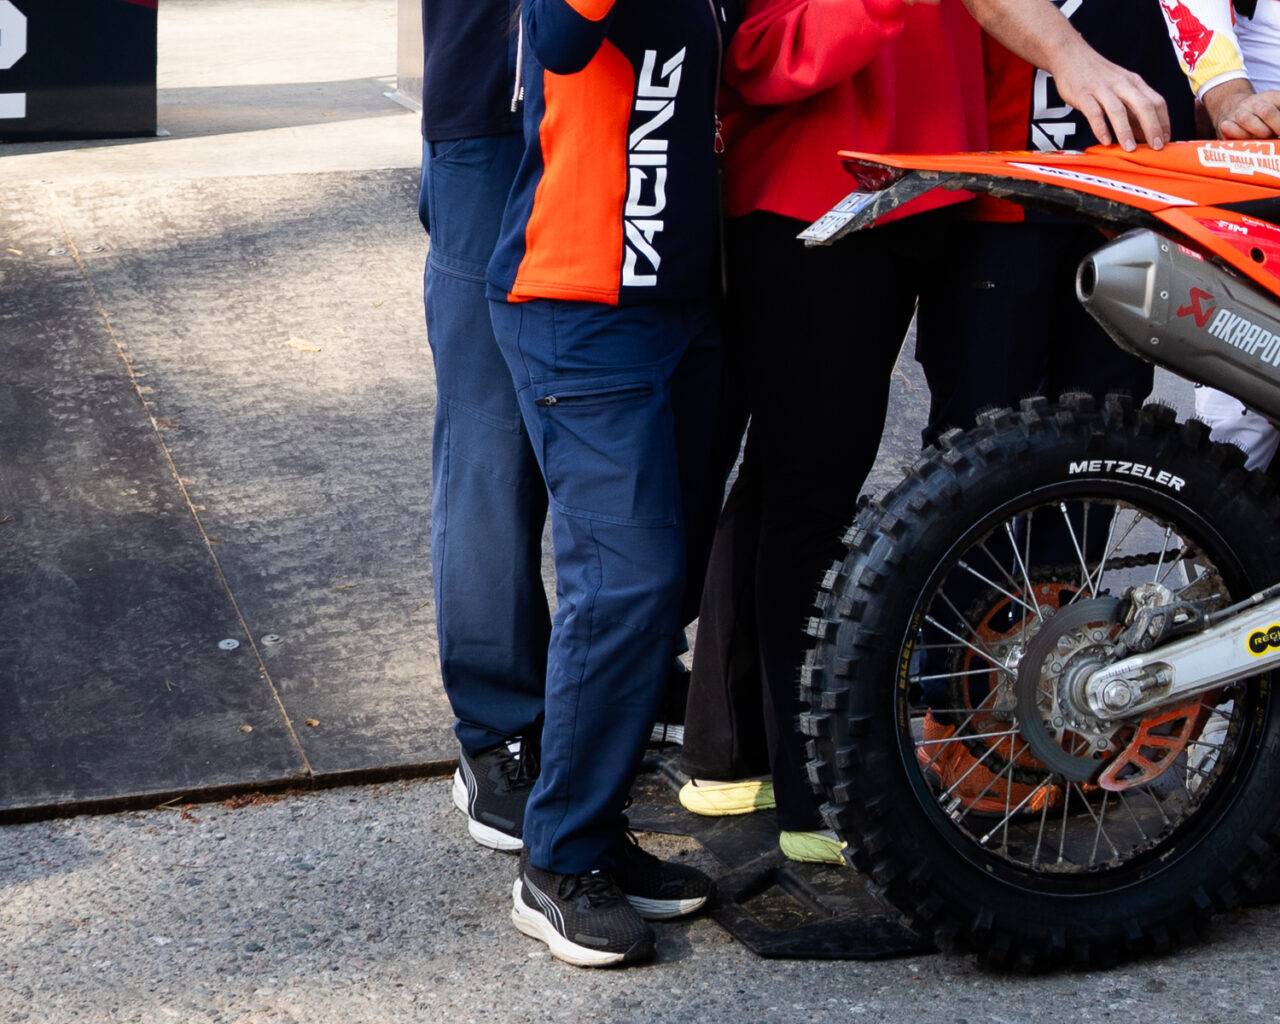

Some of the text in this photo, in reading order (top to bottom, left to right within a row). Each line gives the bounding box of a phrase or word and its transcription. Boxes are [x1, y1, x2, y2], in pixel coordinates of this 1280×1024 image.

[1203, 149, 1280, 172] SELLE DALLA VALLE
[1069, 460, 1185, 492] METZELER
